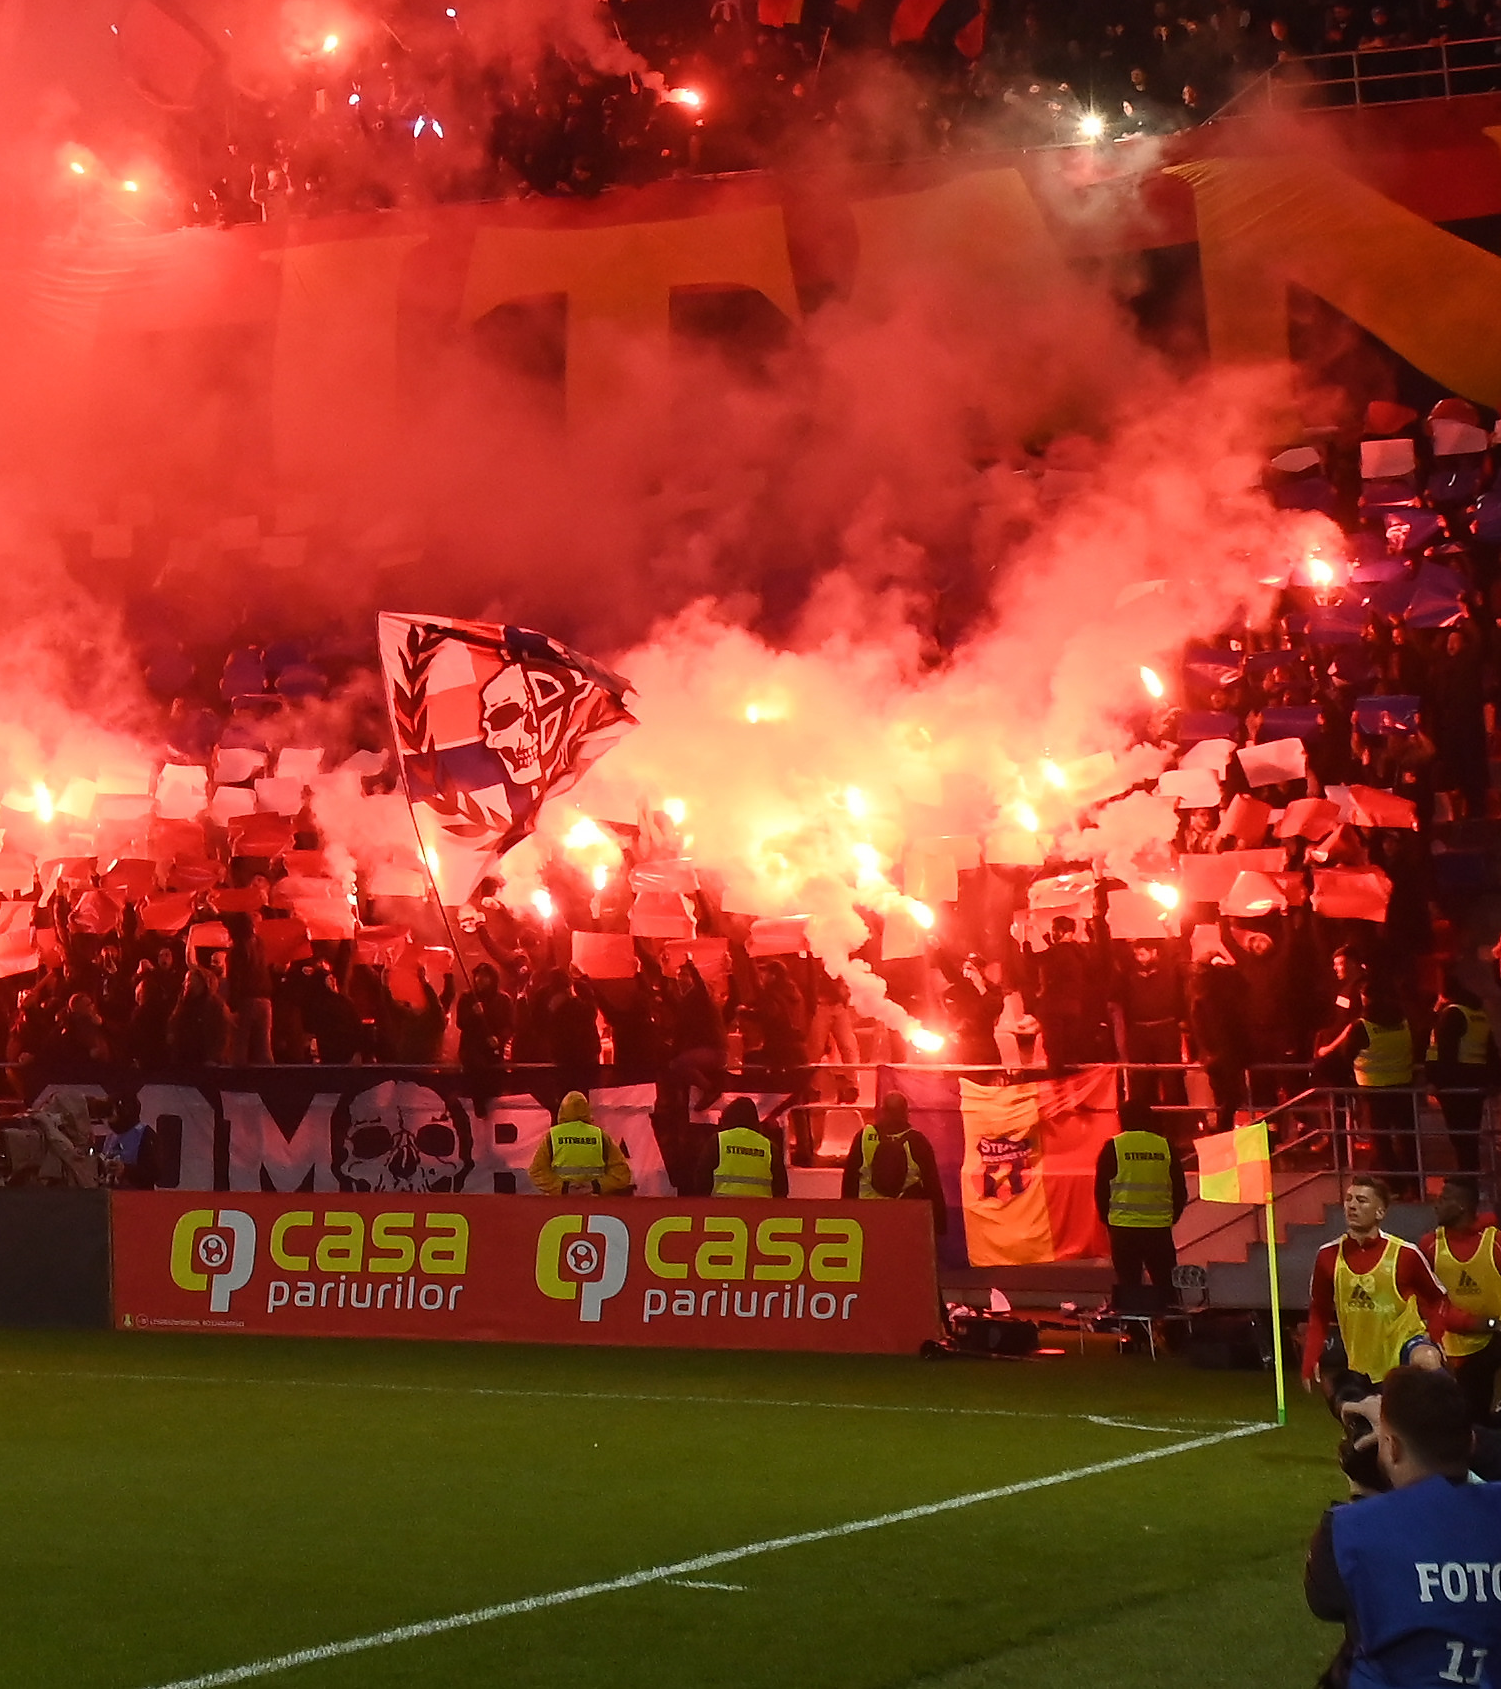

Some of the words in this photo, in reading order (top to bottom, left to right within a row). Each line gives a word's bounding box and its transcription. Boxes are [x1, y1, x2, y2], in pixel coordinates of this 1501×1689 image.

[726, 1145, 766, 1158] STEWARD
[1124, 1152, 1166, 1162] STEWARD
[270, 1211, 469, 1275] casa
[643, 1215, 864, 1283] casa
[267, 1276, 463, 1313] pariurilor
[642, 1285, 858, 1323] pariurilor
